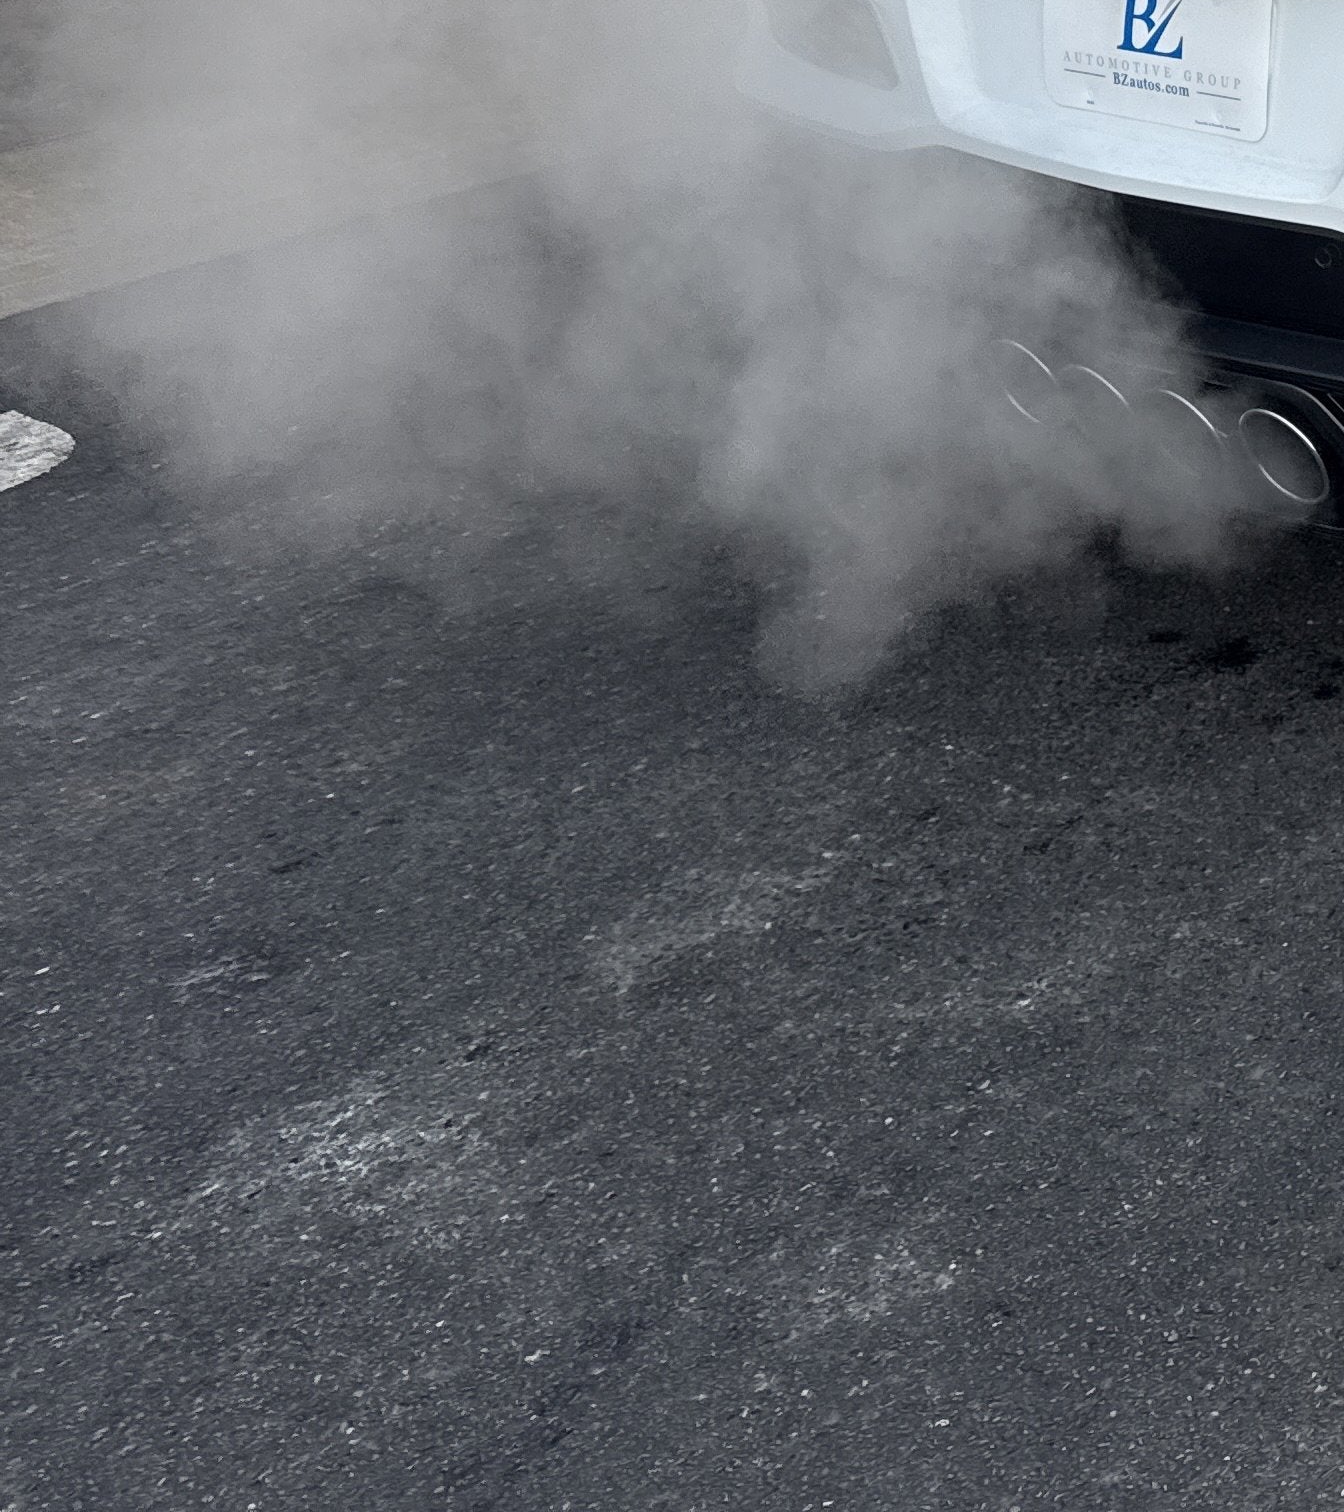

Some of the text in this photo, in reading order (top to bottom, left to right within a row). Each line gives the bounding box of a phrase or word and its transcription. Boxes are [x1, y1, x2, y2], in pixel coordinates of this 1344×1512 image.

[1063, 50, 1241, 90] AUTOMOTIVE GROUP
[1112, 72, 1190, 97] BZautos.com
